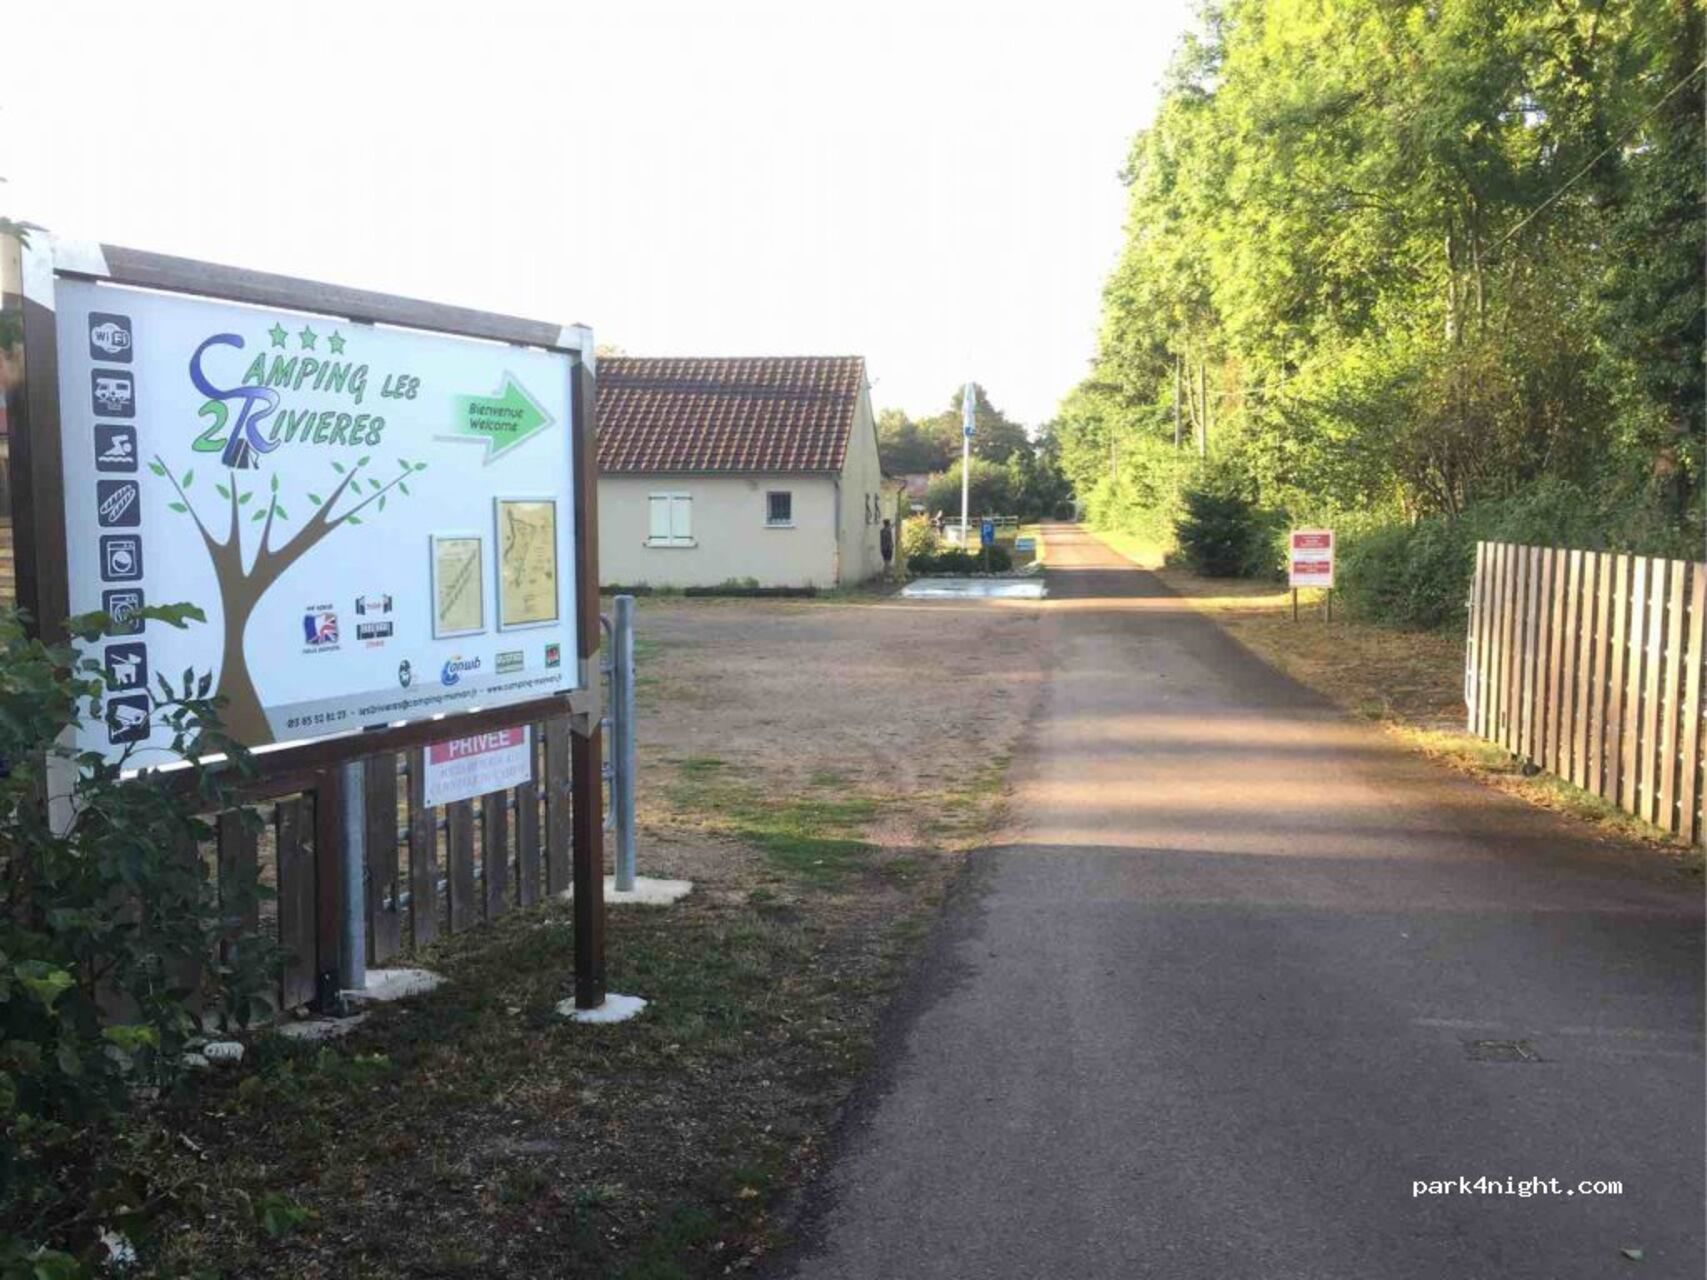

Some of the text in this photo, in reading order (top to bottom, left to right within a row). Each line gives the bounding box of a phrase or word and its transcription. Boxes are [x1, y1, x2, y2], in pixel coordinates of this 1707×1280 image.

[189, 333, 370, 405] CAMPING
[191, 399, 229, 452] 2
[469, 402, 524, 419] Bienvenue
[469, 417, 519, 432] Welcome
